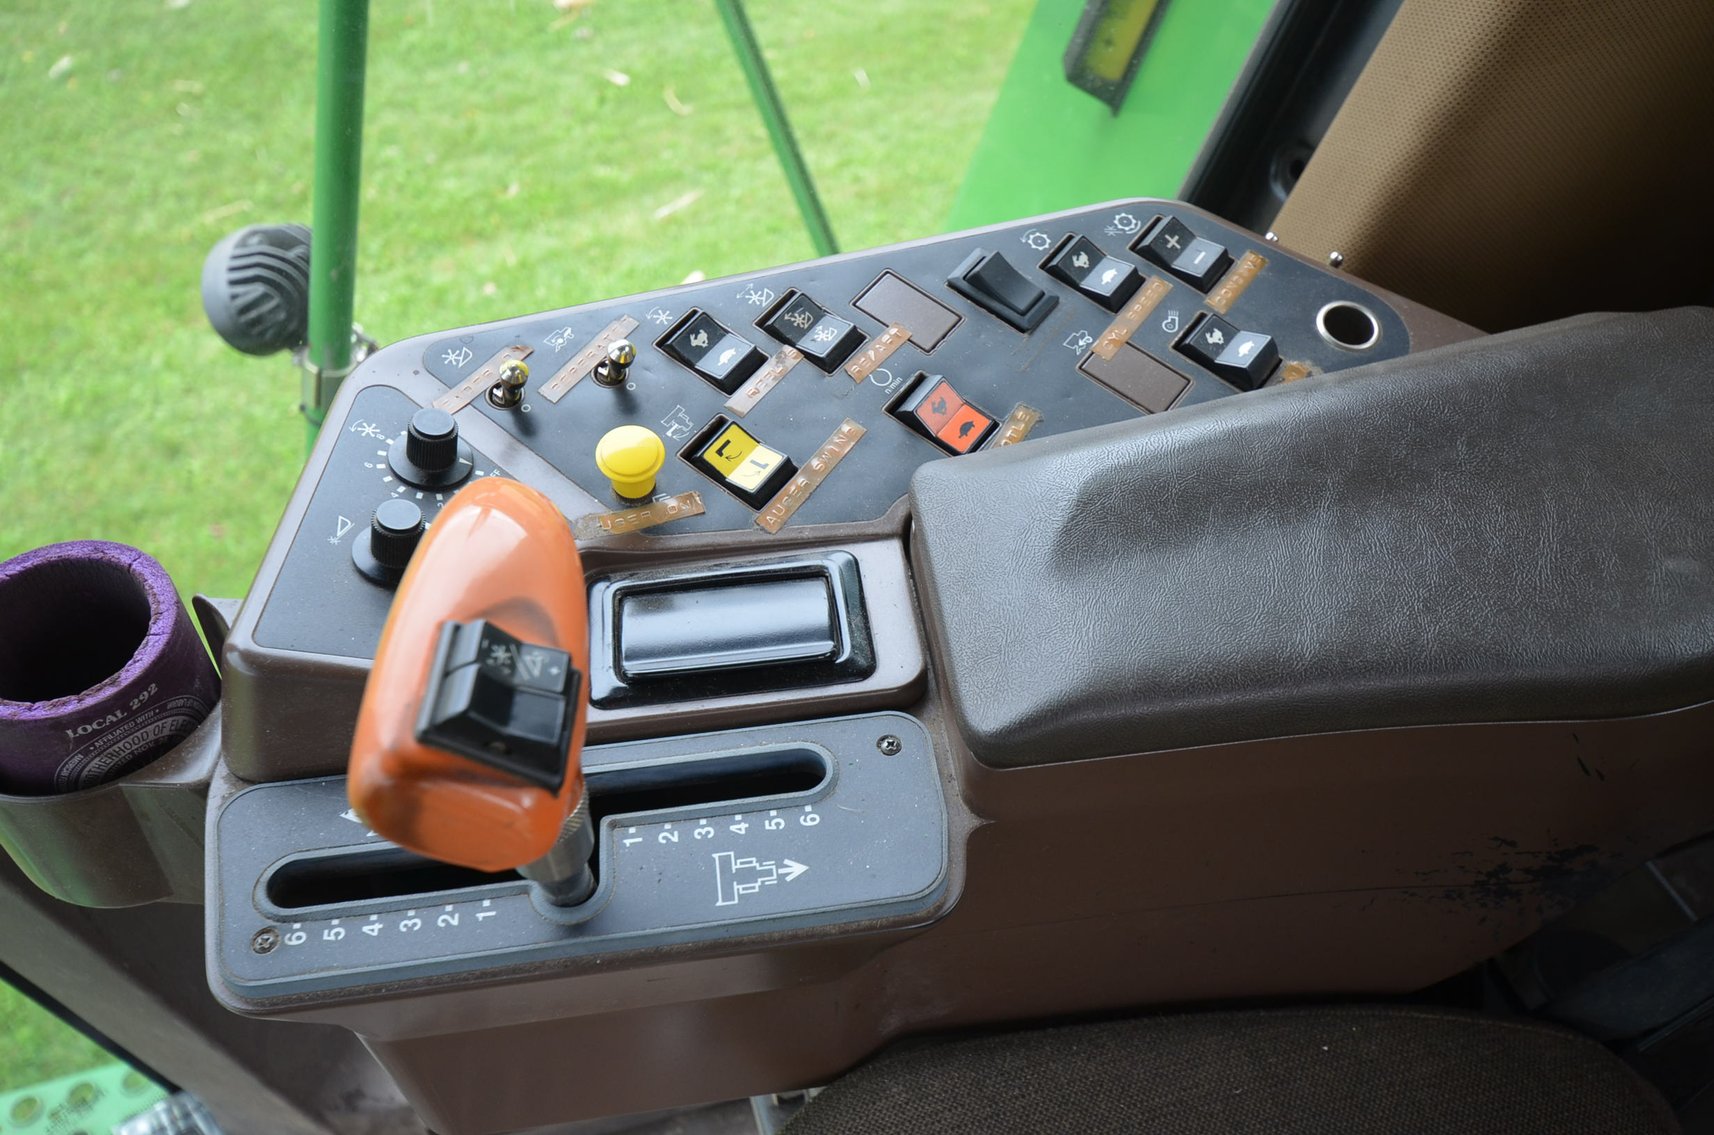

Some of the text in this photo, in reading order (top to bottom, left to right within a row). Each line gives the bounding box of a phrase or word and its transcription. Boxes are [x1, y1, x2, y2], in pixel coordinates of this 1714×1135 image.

[1126, 280, 1164, 322] SPEED
[766, 476, 810, 526] AUGER
[65, 683, 159, 740] LOCAL 292
[94, 719, 136, 749] AFFILIATED
[135, 709, 155, 724] WITH
[153, 721, 168, 737] OF
[622, 813, 821, 848] 1 2 3 4 5 6
[284, 910, 497, 946] 6 5 4 3 2 1
